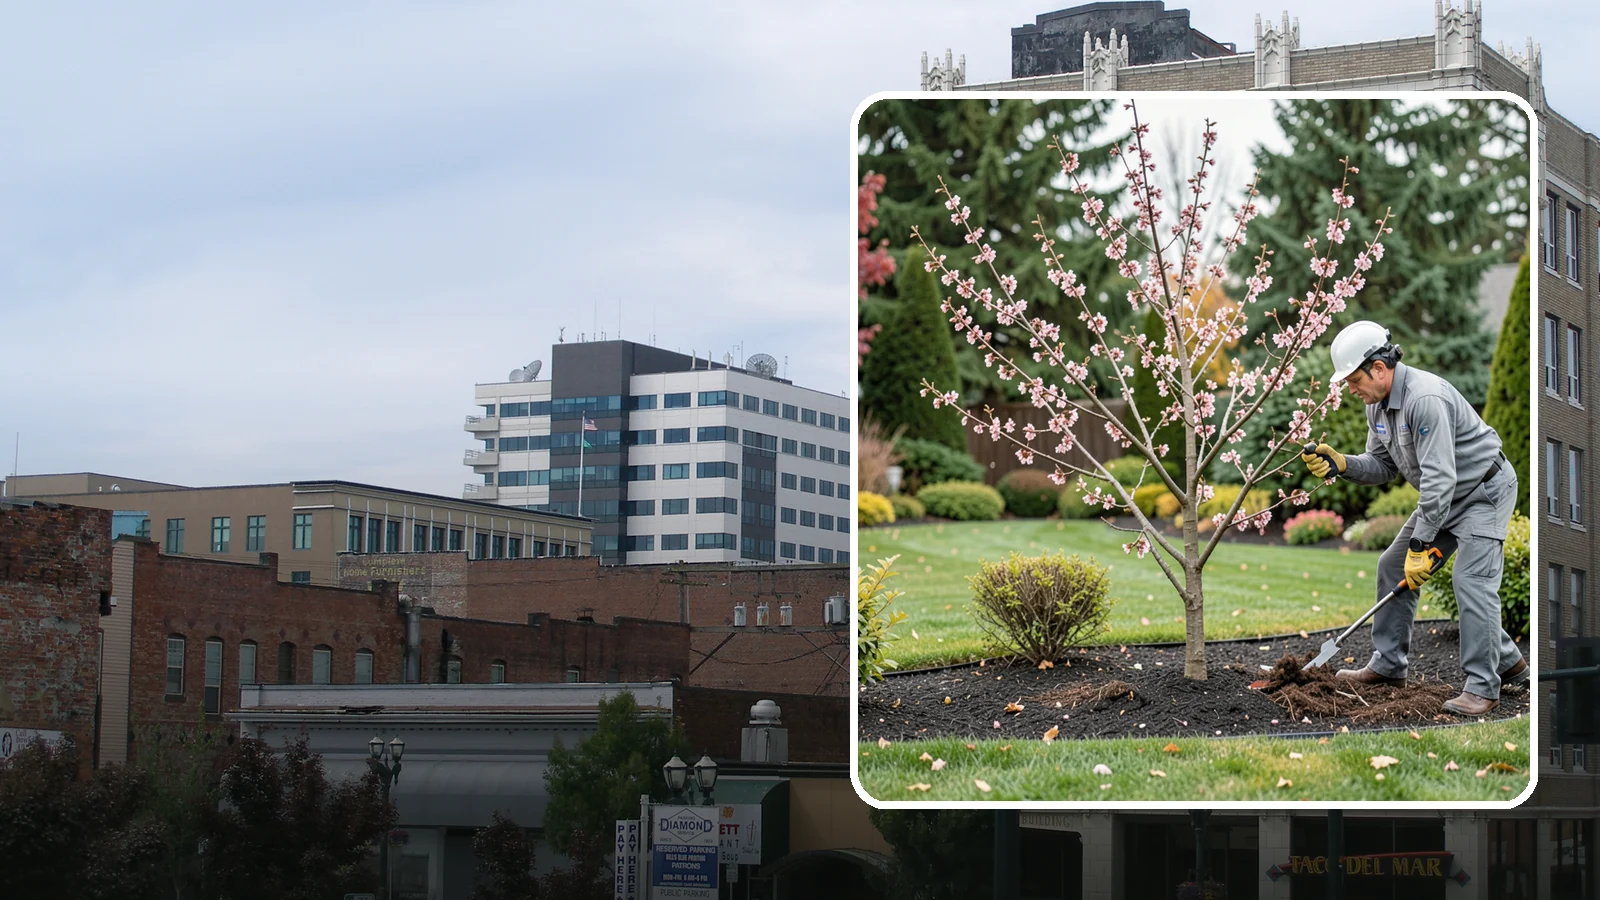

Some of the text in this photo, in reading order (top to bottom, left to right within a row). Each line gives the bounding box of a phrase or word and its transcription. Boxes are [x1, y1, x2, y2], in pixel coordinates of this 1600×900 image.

[370, 566, 427, 576] Furnishers
[660, 818, 713, 833] DIAMOND
[1022, 816, 1070, 827] BUILDING
[616, 825, 625, 893] PAY HERE
[627, 824, 637, 893] PAY HERE
[671, 862, 701, 870] PATRONS
[1345, 856, 1384, 875] DEL
[1392, 857, 1442, 877] MAR
[660, 888, 710, 898] PUBLIC PARKING
